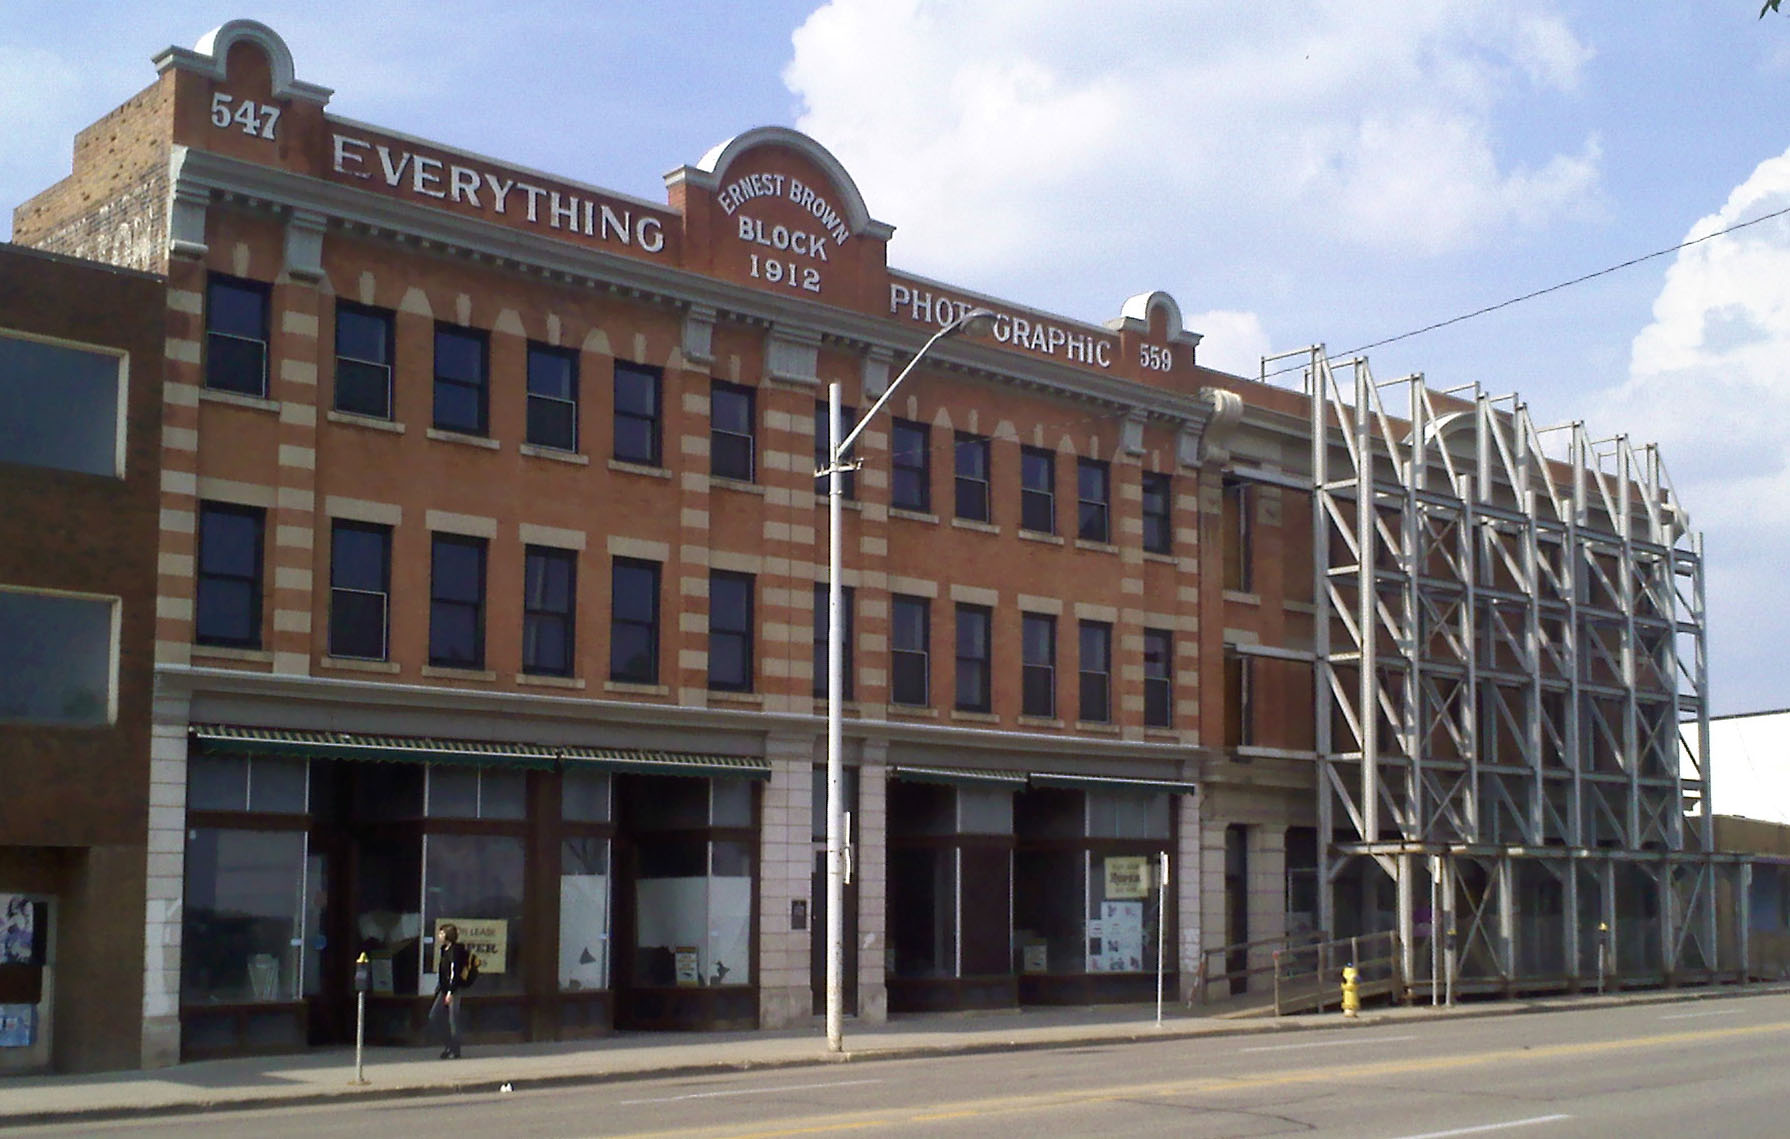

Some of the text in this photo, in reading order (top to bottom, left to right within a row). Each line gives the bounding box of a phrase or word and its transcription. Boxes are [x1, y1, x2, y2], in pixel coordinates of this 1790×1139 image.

[211, 92, 281, 140] 547
[333, 134, 665, 252] EVERYTHING
[718, 173, 849, 246] ERNEST BROWN
[738, 215, 828, 261] BLOCK
[750, 254, 821, 293] 1912
[890, 284, 1111, 368] PHOTGRAPHIC
[1140, 343, 1172, 372] 559
